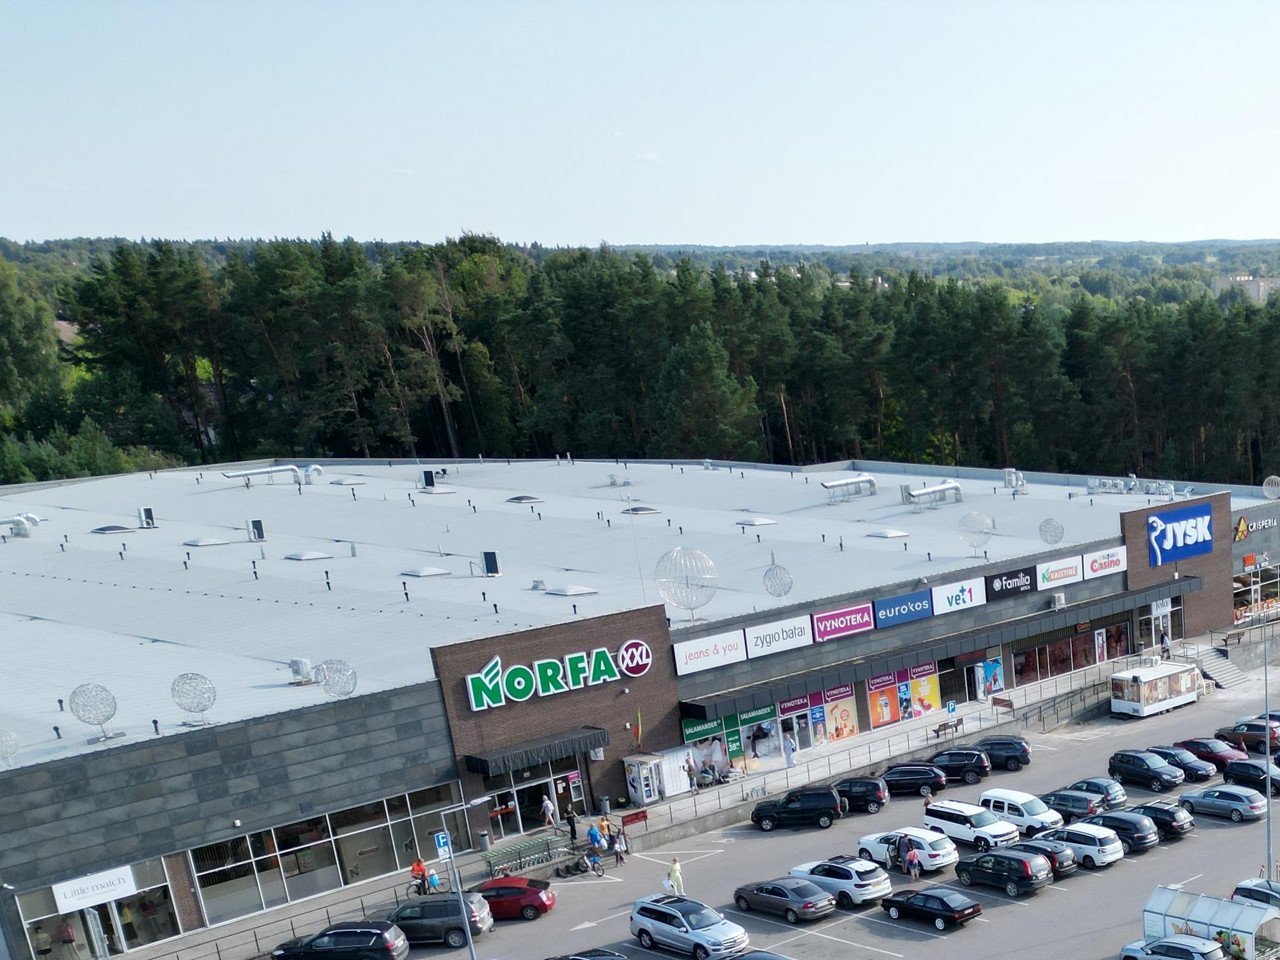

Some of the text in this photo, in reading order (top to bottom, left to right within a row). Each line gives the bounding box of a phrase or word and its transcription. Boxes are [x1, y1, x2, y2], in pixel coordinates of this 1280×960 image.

[1162, 515, 1212, 550] JYSK
[1248, 518, 1277, 532] CRISPERIA
[1090, 559, 1121, 573] Casino
[818, 612, 870, 632] VYNOTEKA
[781, 625, 806, 641] batai
[684, 641, 739, 665] jeans & you
[465, 645, 651, 711] NORFA XXL
[949, 702, 955, 712] P
[438, 834, 447, 847] P
[92, 877, 126, 892] match
